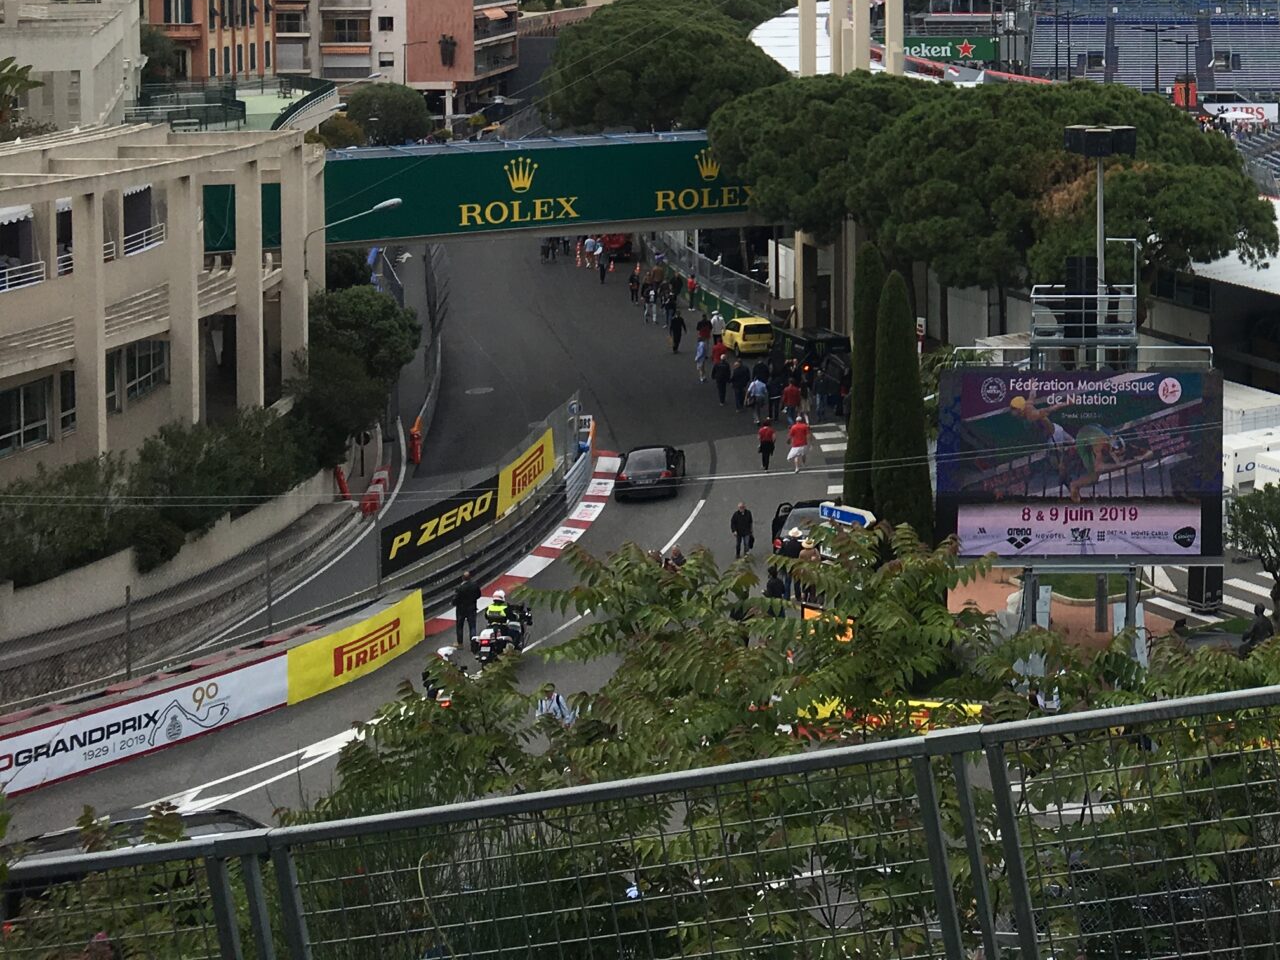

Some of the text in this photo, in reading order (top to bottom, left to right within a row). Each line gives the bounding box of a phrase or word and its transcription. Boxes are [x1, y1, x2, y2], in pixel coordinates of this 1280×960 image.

[904, 42, 951, 57] neken
[458, 196, 581, 226] ROLEX
[1009, 377, 1074, 391] Fédération
[1077, 377, 1155, 394] Monégasque
[1046, 392, 1117, 405] de Natation
[511, 443, 545, 499] PIRELLI
[388, 490, 494, 561] P ZERO
[1021, 506, 1139, 524] 8 & 9 juin 2019
[1007, 528, 1032, 536] arena
[333, 617, 401, 677] PIRELLI
[192, 682, 219, 712] 90
[83, 745, 109, 762] 1929
[119, 734, 147, 751] 2019
